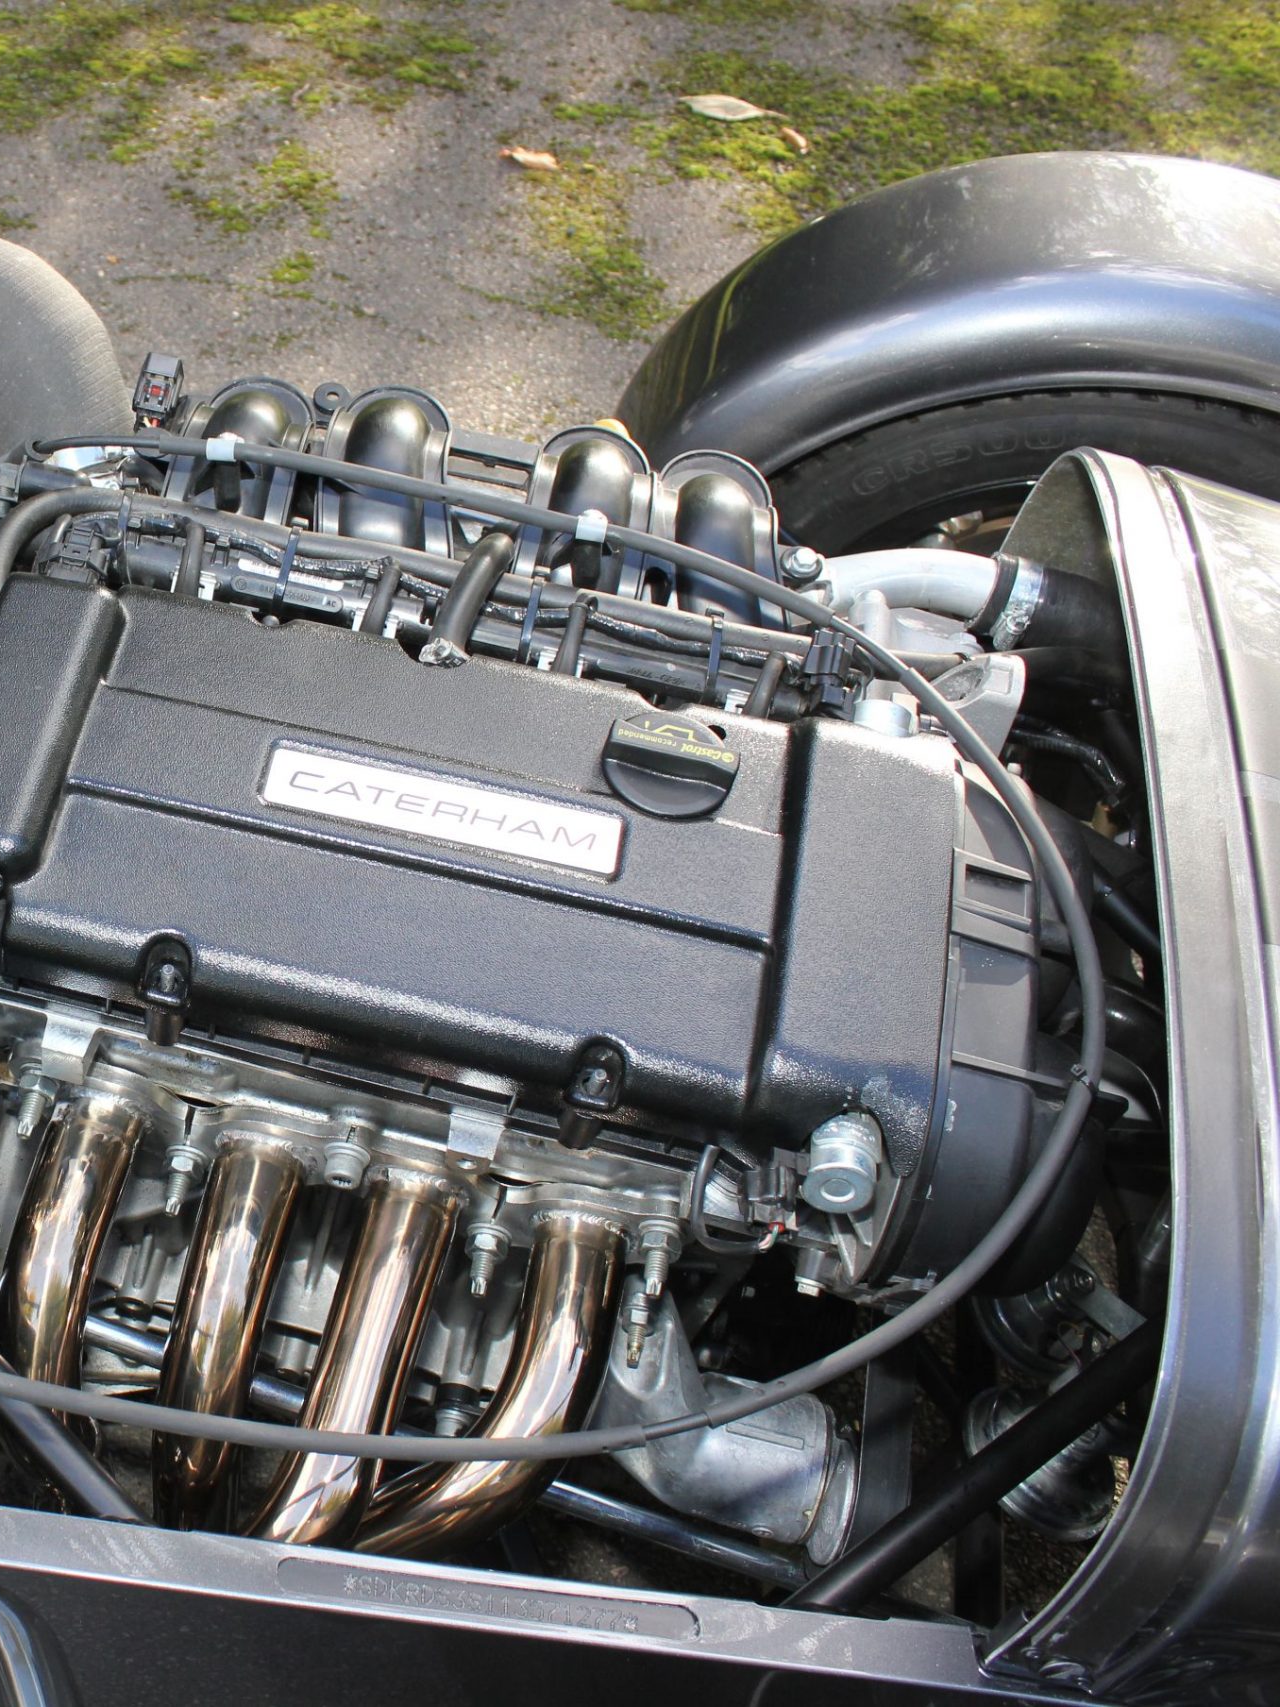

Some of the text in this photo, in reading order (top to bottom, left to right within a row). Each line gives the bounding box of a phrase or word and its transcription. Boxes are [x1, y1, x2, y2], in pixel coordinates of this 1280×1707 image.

[852, 424, 1066, 497] CR500
[618, 728, 722, 760] Castrol recommended
[288, 769, 598, 851] CATERHAM
